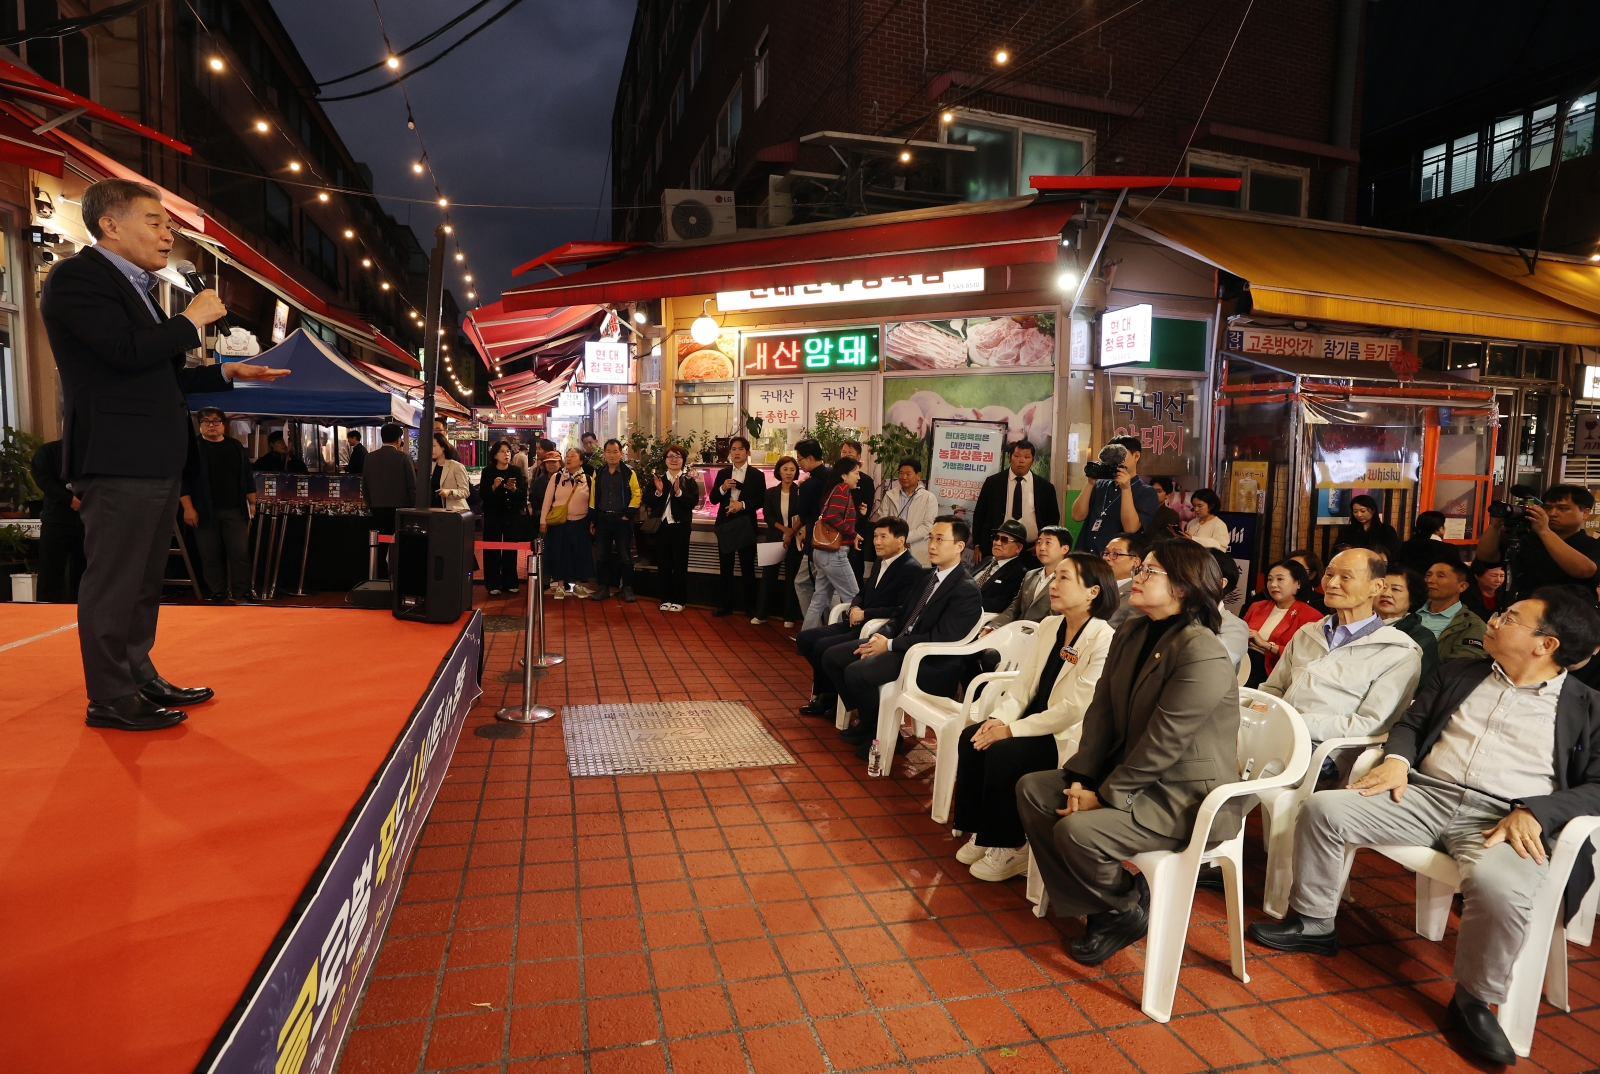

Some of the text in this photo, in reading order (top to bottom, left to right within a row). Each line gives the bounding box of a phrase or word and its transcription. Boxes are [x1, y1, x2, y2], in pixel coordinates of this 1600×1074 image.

[1110, 316, 1131, 334] 현대
[1105, 333, 1136, 352] 정육점
[1247, 335, 1313, 357] 고추방앗간
[1323, 340, 1360, 360] 참기름
[596, 349, 619, 361] 현대
[804, 334, 878, 368] 암돼
[590, 362, 624, 374] 정육점
[760, 389, 795, 404] 국내산
[820, 386, 859, 402] 국내산
[1115, 391, 1189, 423] 국내산
[950, 441, 980, 450] 대한민국
[938, 448, 994, 463] 농할상품권
[942, 461, 987, 472] 가맹점입니다
[1367, 468, 1400, 483] Whisky
[375, 766, 411, 889] 푸드
